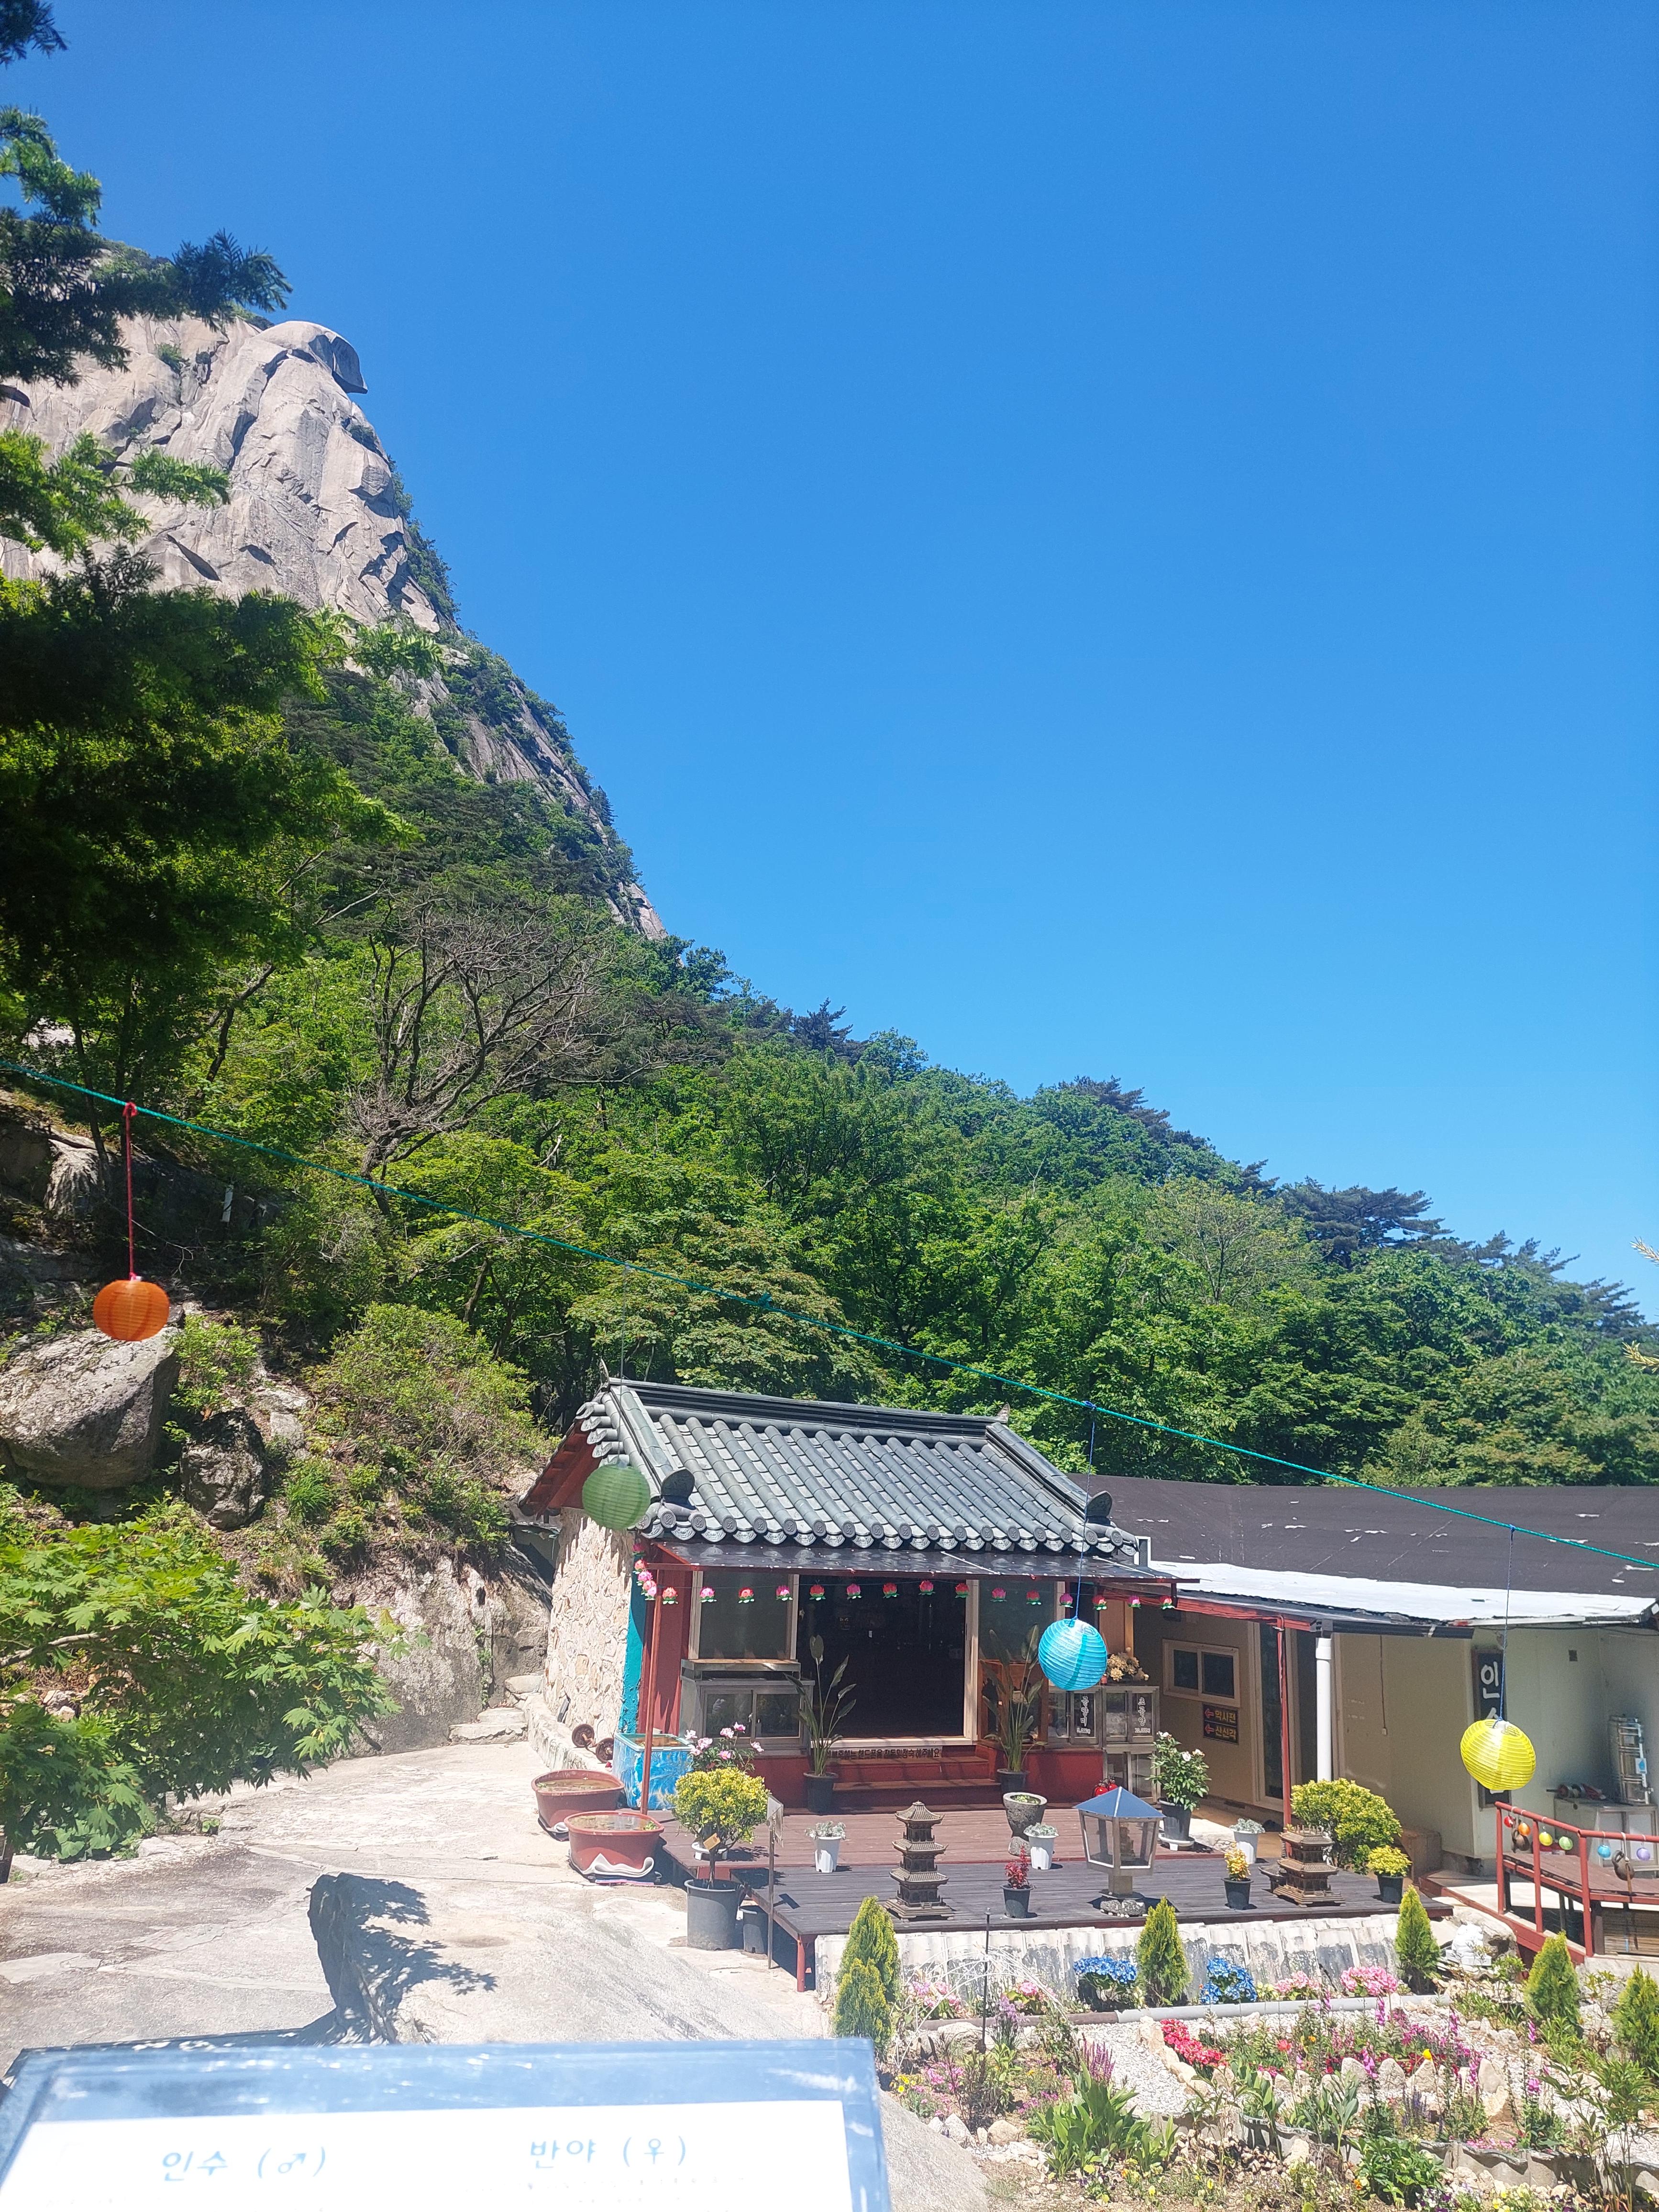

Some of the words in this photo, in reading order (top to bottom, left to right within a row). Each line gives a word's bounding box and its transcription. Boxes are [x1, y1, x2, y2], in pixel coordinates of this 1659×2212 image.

[1080, 1696, 1089, 1726] 공양미
[1138, 1697, 1146, 1726] 초공양
[1216, 1726, 1236, 1739] 산신각
[162, 2151, 228, 2181] 인수
[530, 2139, 597, 2169] 반야
